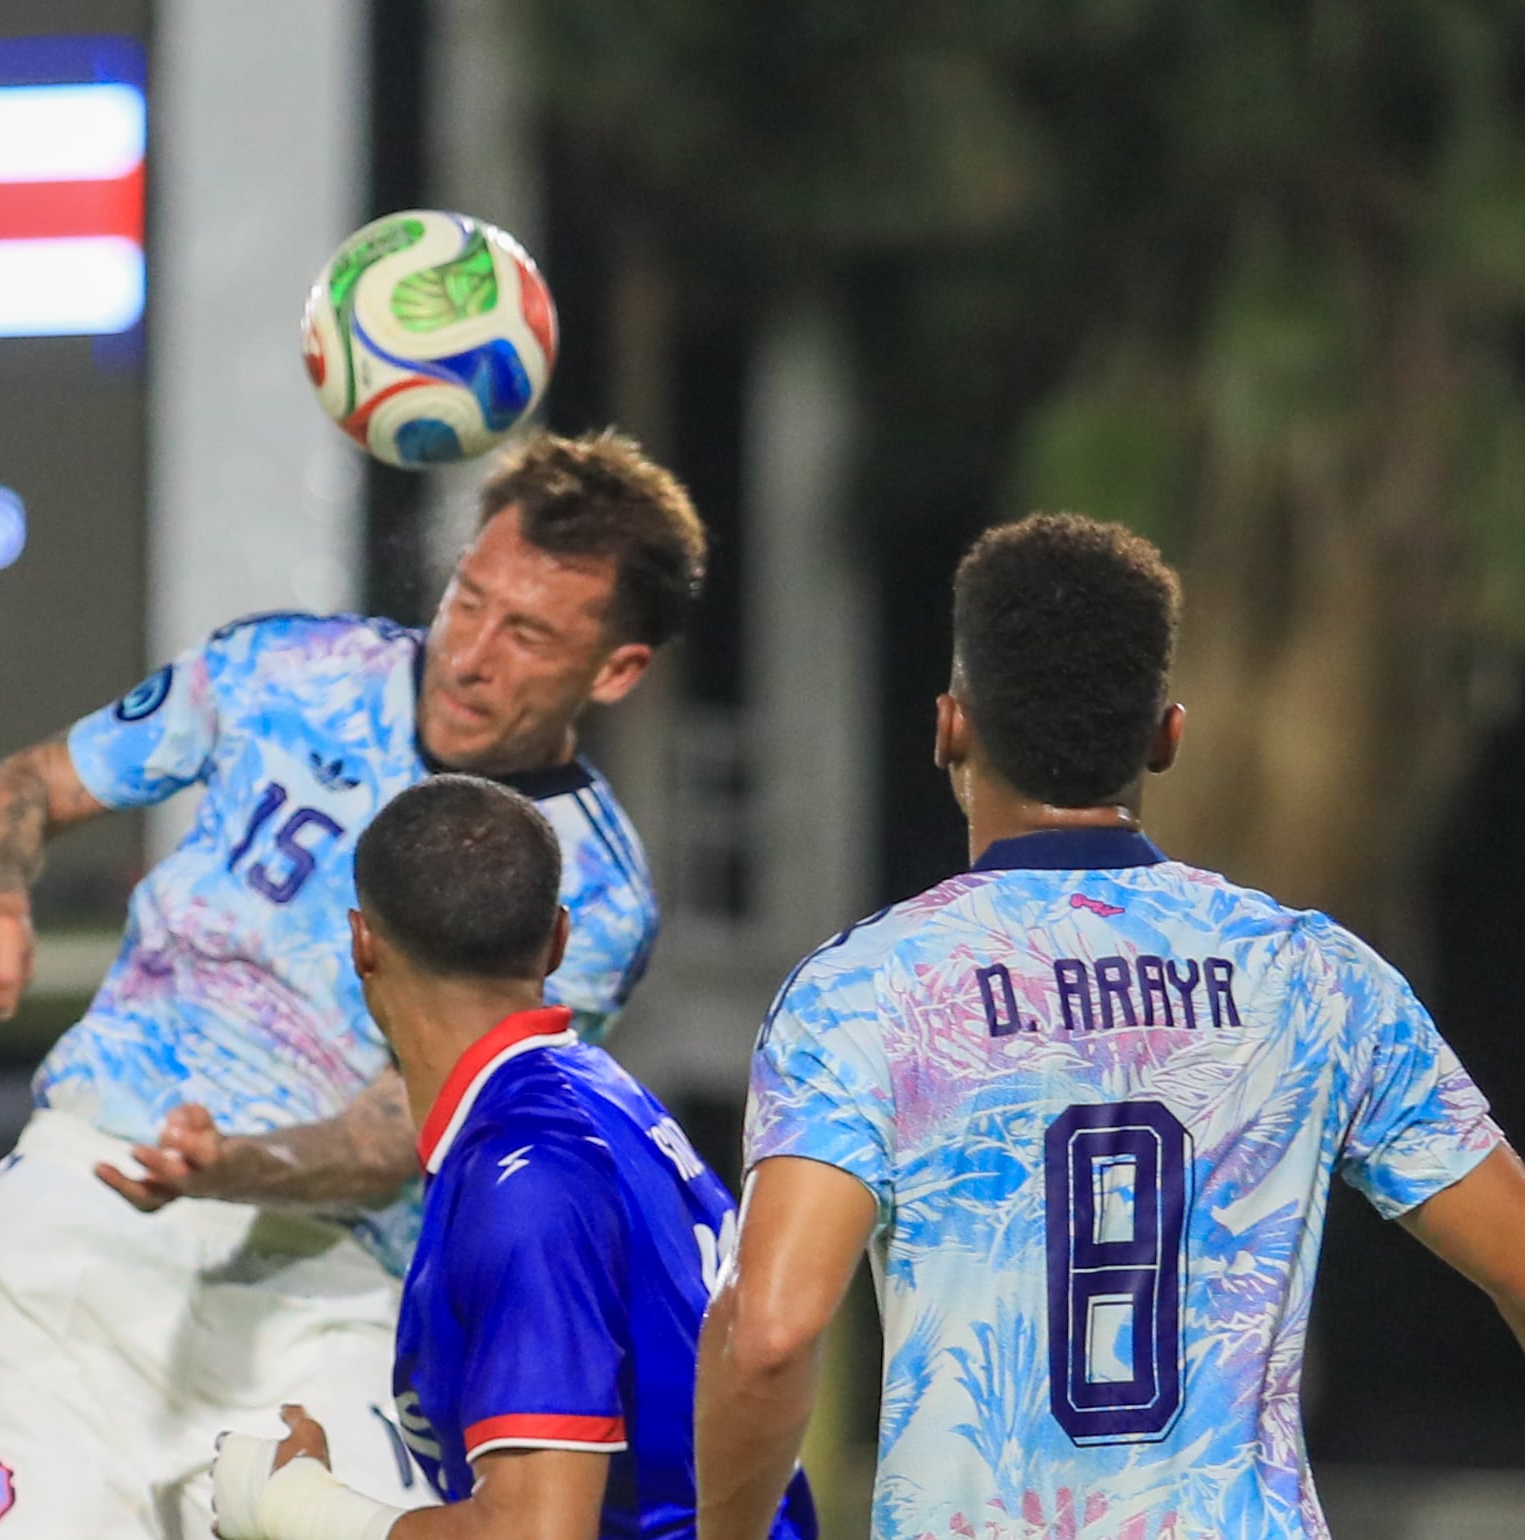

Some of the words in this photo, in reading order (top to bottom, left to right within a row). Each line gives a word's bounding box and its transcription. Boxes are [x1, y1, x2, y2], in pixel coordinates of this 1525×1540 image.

[228, 781, 345, 904] 15
[977, 963, 1038, 1037] D.
[1053, 955, 1242, 1031] ARAYA
[1045, 1101, 1193, 1448] 8
